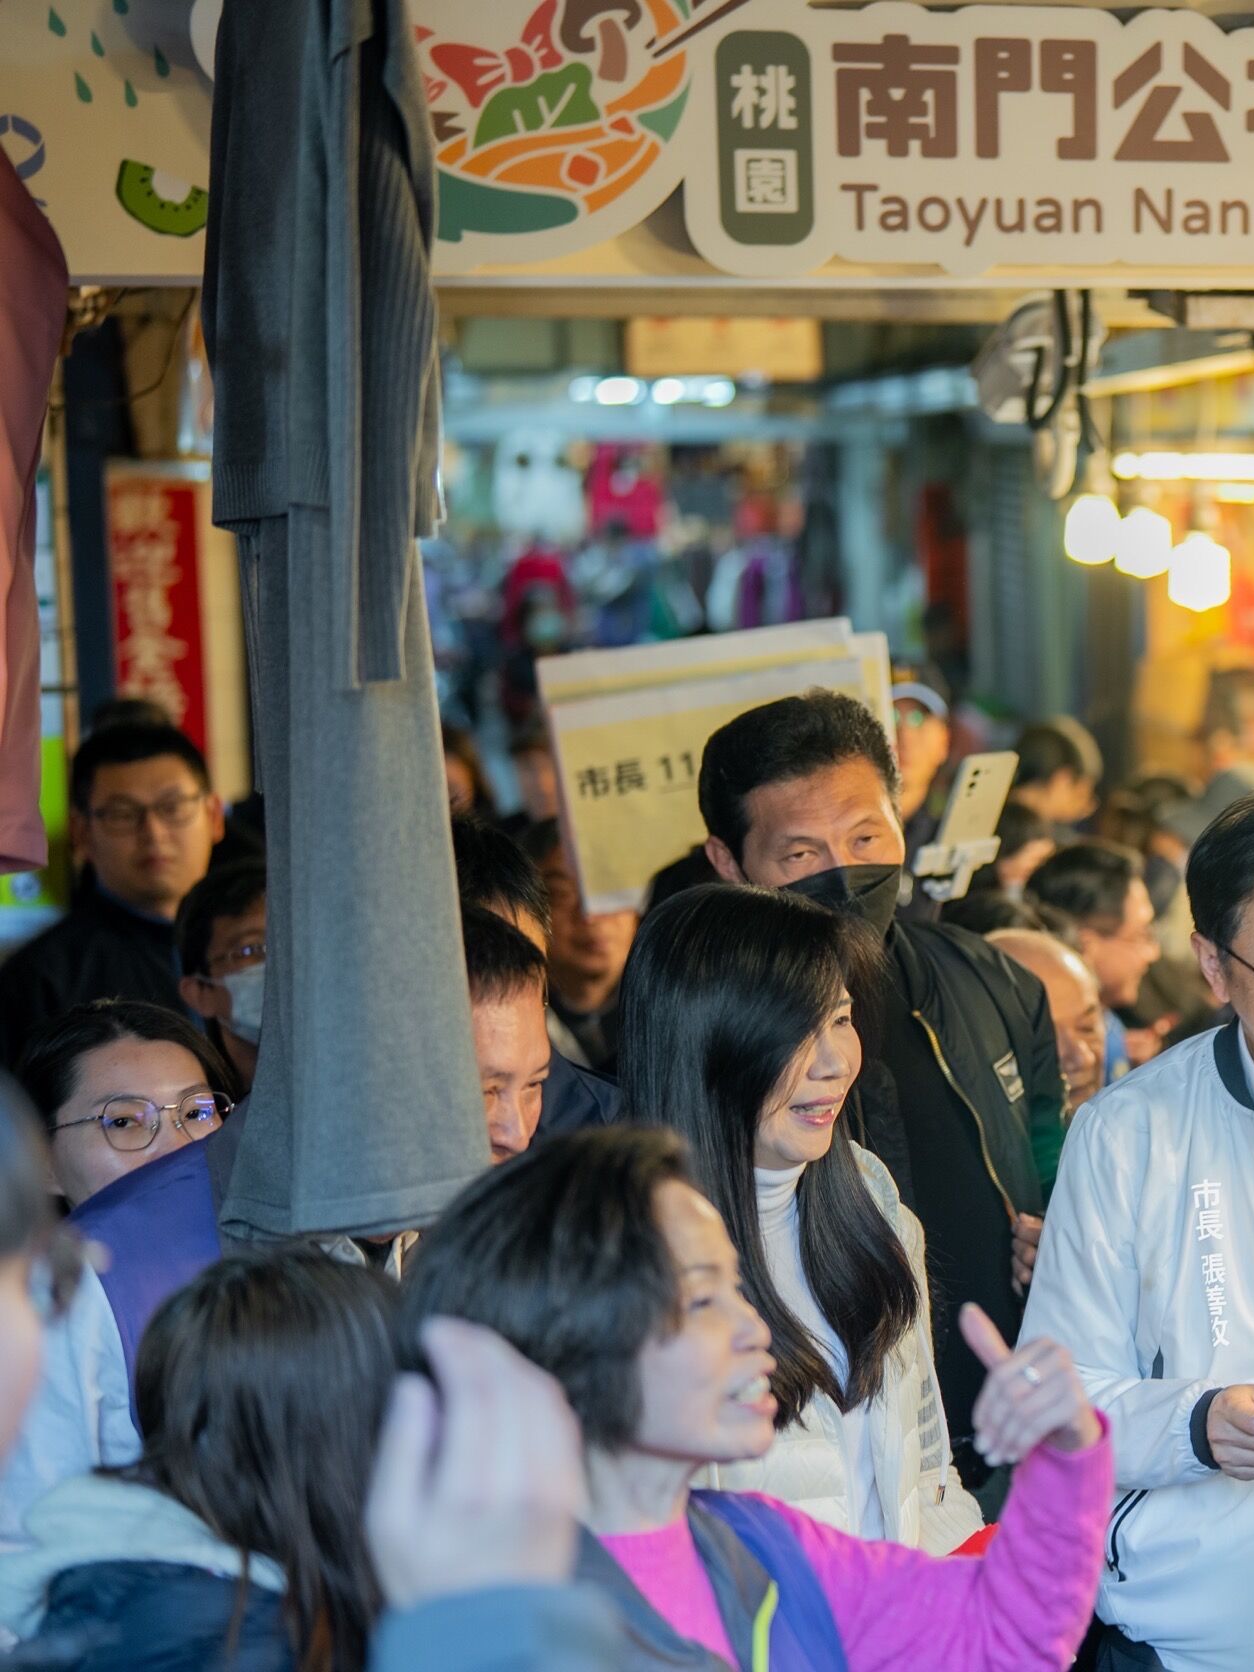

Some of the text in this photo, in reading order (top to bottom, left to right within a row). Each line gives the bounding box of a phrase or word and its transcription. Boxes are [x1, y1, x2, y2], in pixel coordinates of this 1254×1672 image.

[730, 64, 799, 214] 桃園
[839, 182, 1104, 247] Taoyuan
[575, 757, 648, 800] 市長
[1190, 1179, 1225, 1241] 市長
